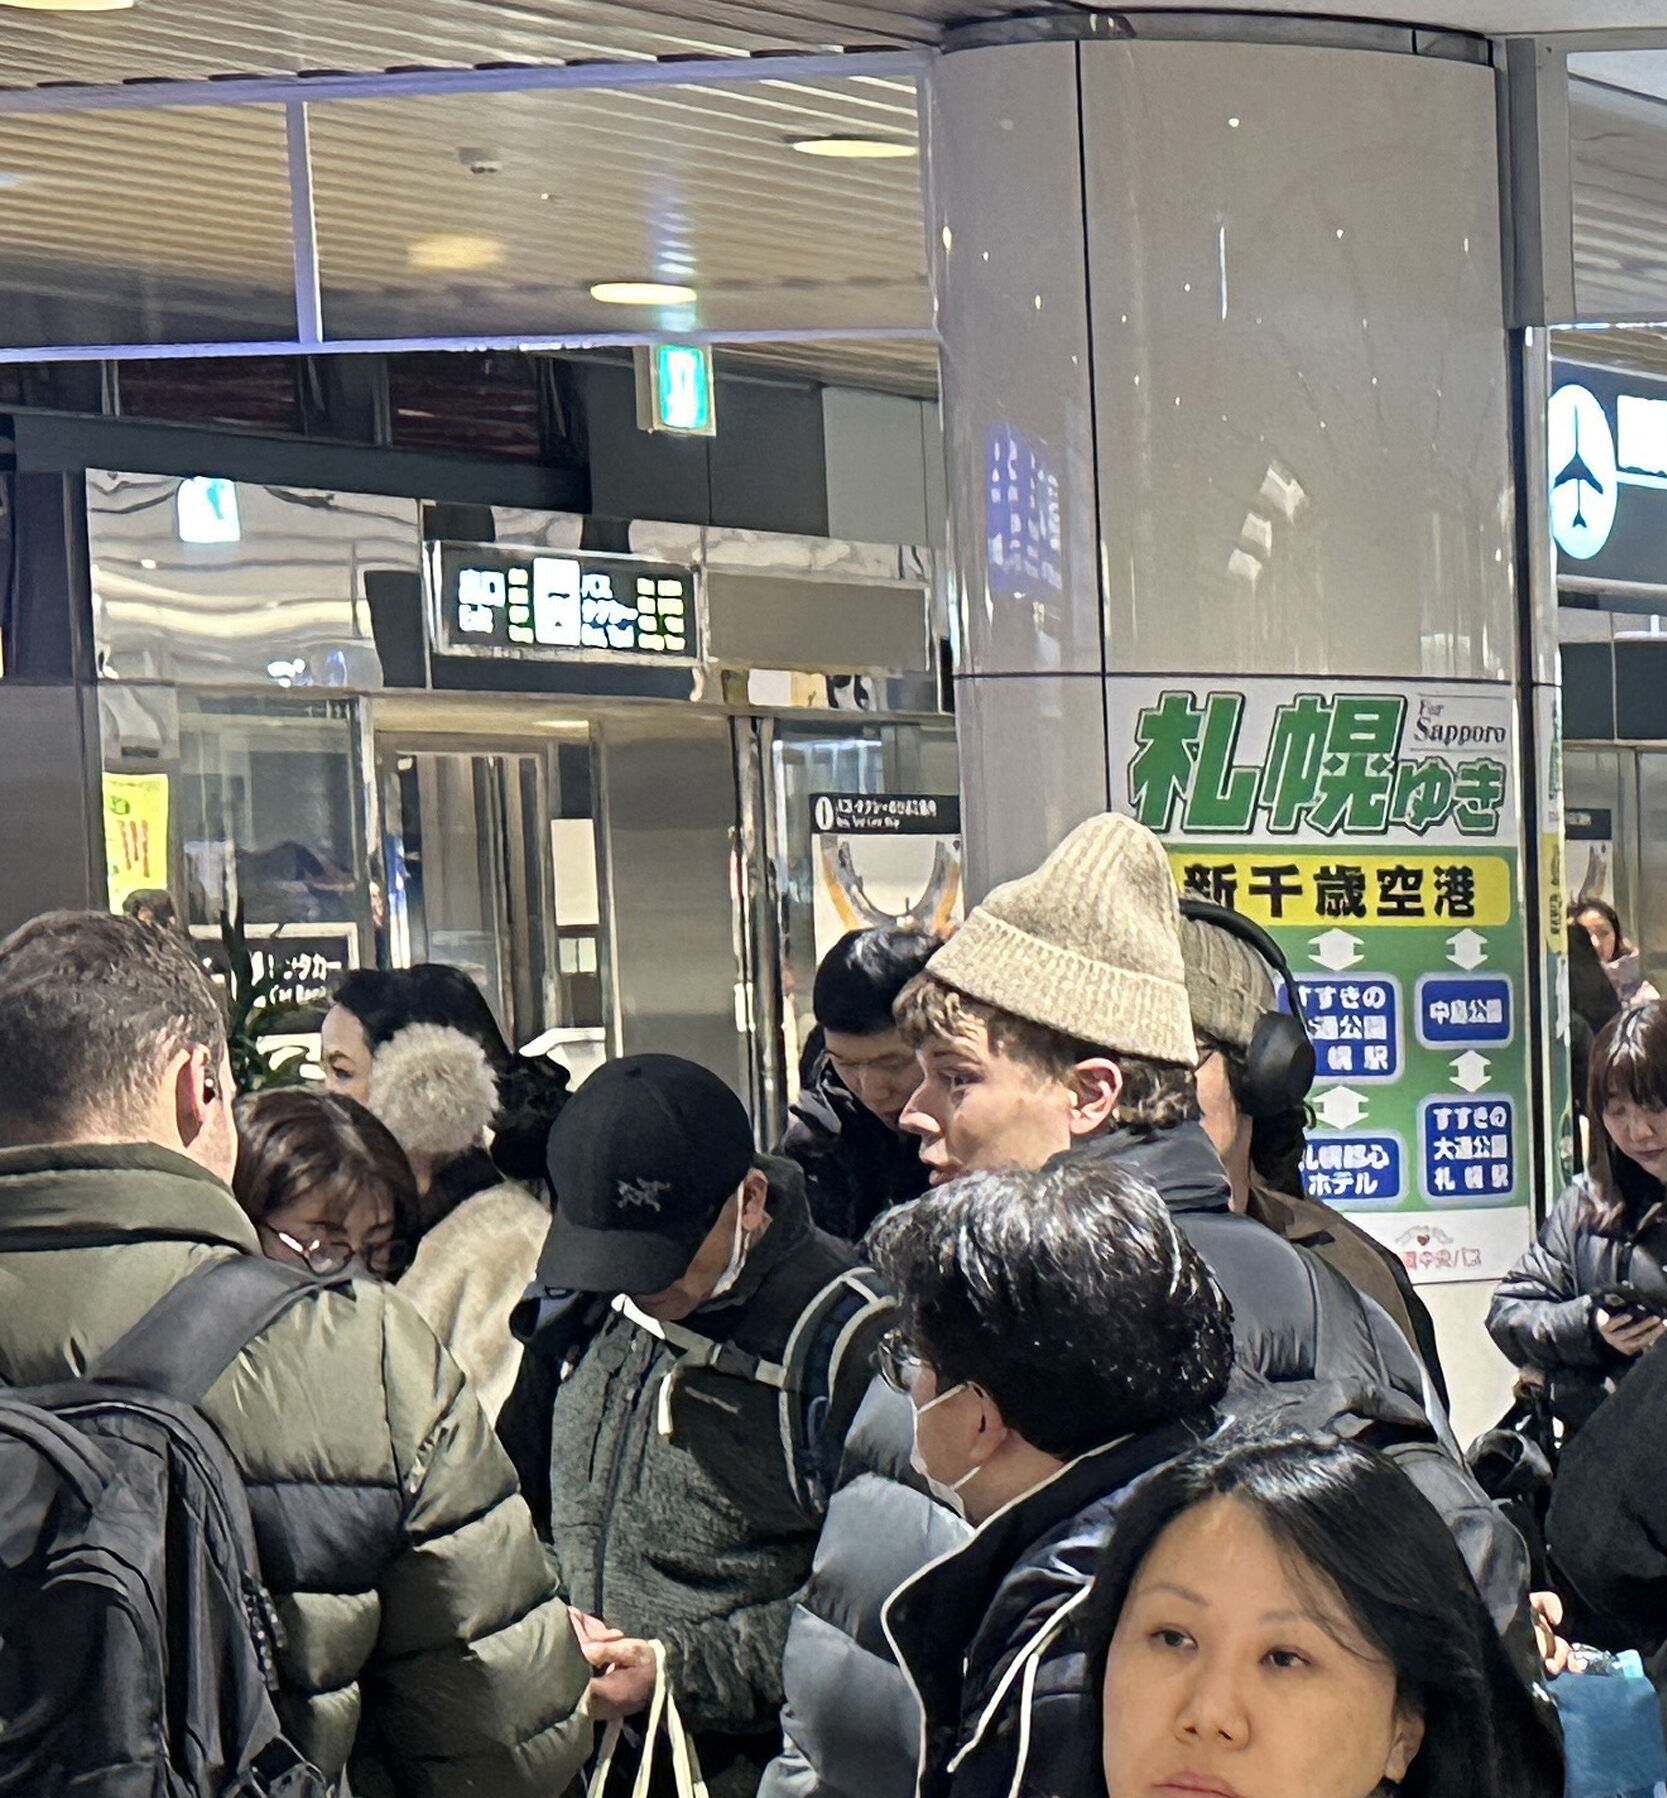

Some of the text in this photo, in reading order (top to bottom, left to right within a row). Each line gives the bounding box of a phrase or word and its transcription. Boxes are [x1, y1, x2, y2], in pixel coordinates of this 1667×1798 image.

[1413, 717, 1507, 746] Sapporo
[1128, 690, 1506, 836] 札幌ゆき
[1183, 863, 1475, 918] 新千歳空港
[1308, 1014, 1388, 1040] 通公園
[1432, 1106, 1507, 1130] すすきの
[1307, 1170, 1378, 1196] ホテル
